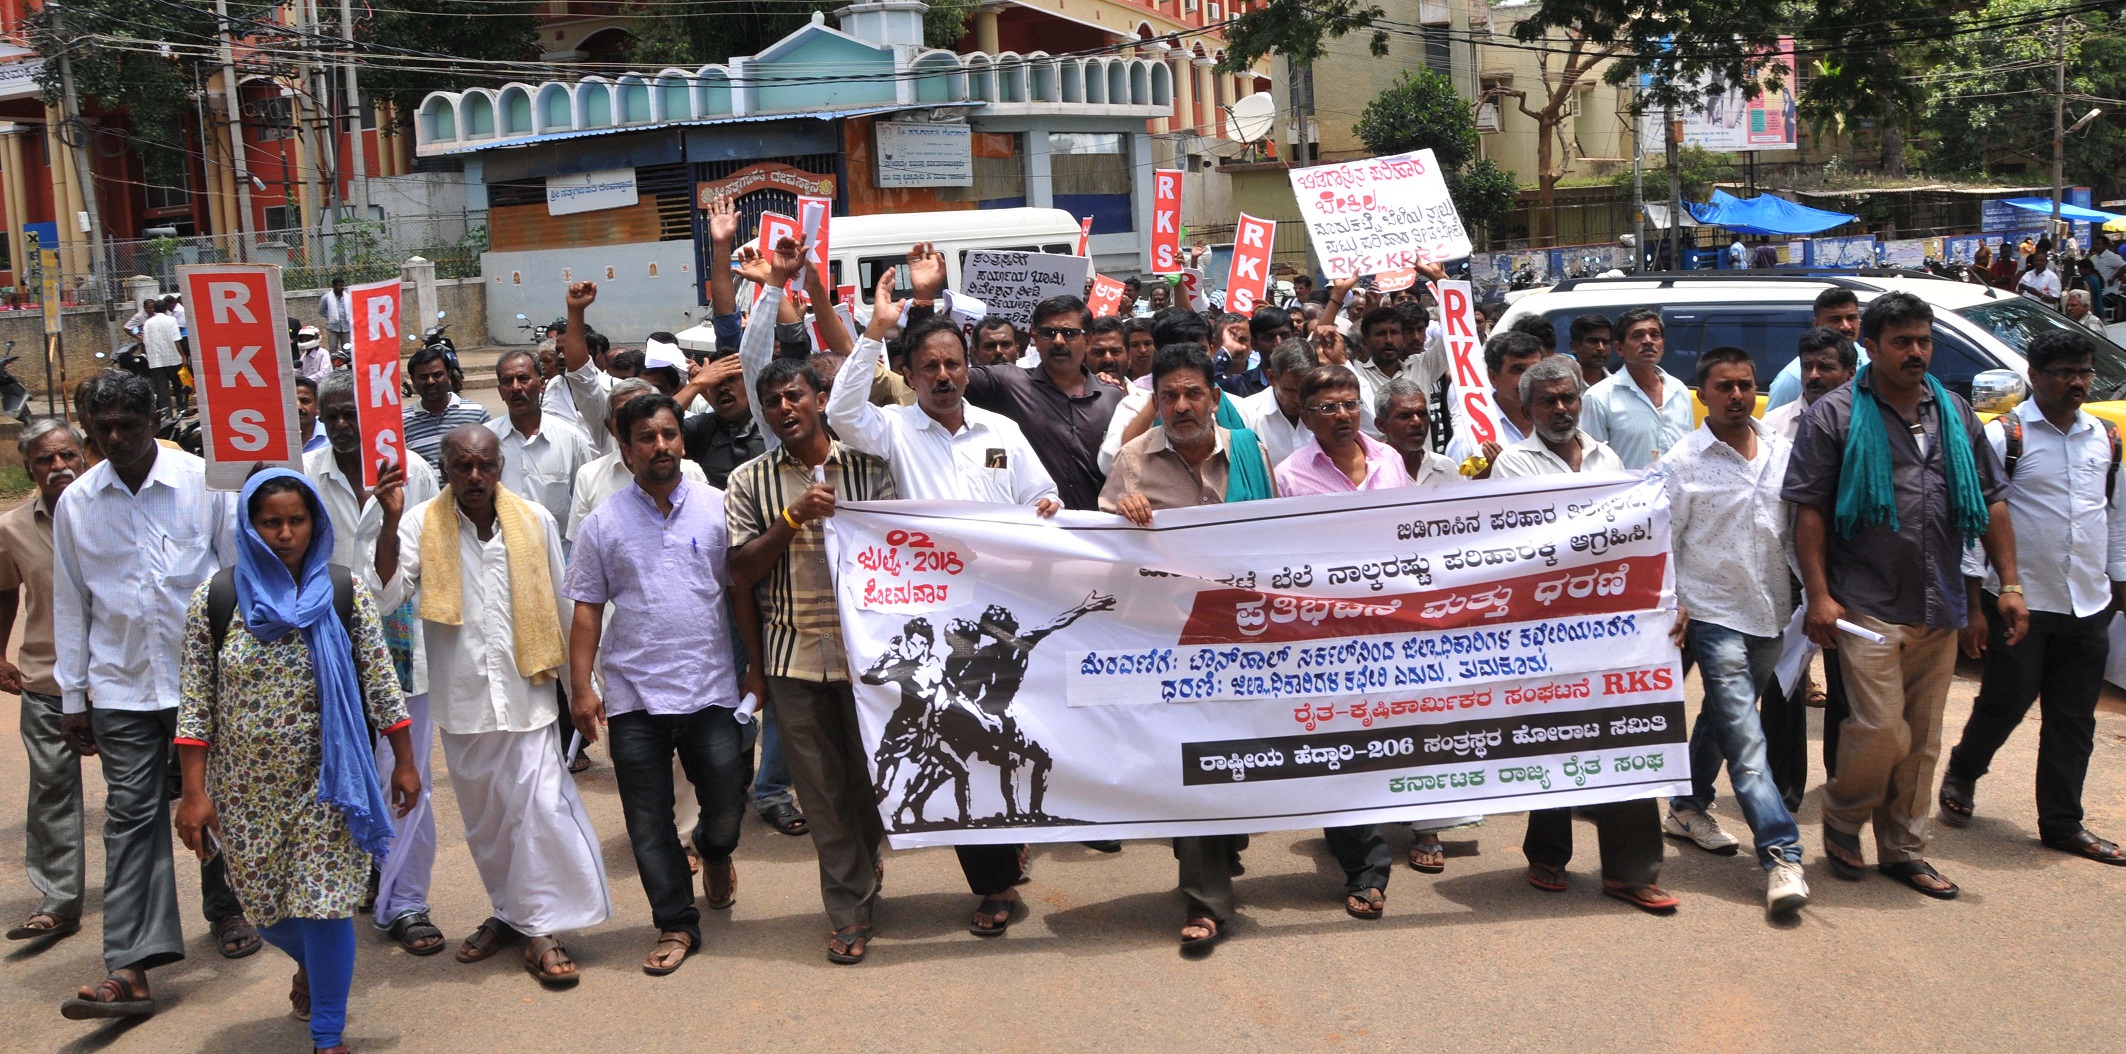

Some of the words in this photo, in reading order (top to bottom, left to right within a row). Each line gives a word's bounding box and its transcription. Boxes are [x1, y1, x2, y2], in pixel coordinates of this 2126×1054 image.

[1369, 159, 1425, 181] ಪರಿಹಾರ
[1157, 175, 1175, 268] RKS
[1232, 222, 1265, 312] RKS
[208, 281, 270, 452] RKS
[366, 294, 400, 472] RKS
[1443, 289, 1497, 445] RKS
[886, 529, 935, 548] 02
[1272, 564, 1313, 590] ಬೆಲೆ
[1327, 551, 1433, 592] ನಾಲ್ಕರಷ್ಟು
[1570, 517, 1652, 556] ಆಗ್ರಹಿಸಿ!
[1397, 511, 1480, 541] ಬಿಡಿಗಾಸಿನ
[1490, 502, 1557, 531] ಪರಿಹಾರ
[863, 578, 949, 608] ಸೋಮವಾರ
[1236, 593, 1402, 636] ಪ್ರತಿಭಟನೆ
[1420, 584, 1513, 619] ಮತ್ತು
[1534, 562, 1630, 606] ಧರಣಿ
[1505, 677, 1590, 706] ಸಂಘಟನೆ
[1602, 667, 1673, 696] RKS
[1199, 747, 1285, 782] ರಾಷ್ಟ್ರೀಯ
[1512, 720, 1600, 746] ಹೋರಾಟ
[1610, 715, 1668, 736] ಸಮಿತಿ
[1388, 769, 1486, 794] ಕರ್ನಾಟಕ
[1498, 763, 1551, 790] ರಾಜ್ಯ
[1563, 755, 1602, 787] ರೈತ
[1614, 751, 1664, 773] ಸಂಘ
